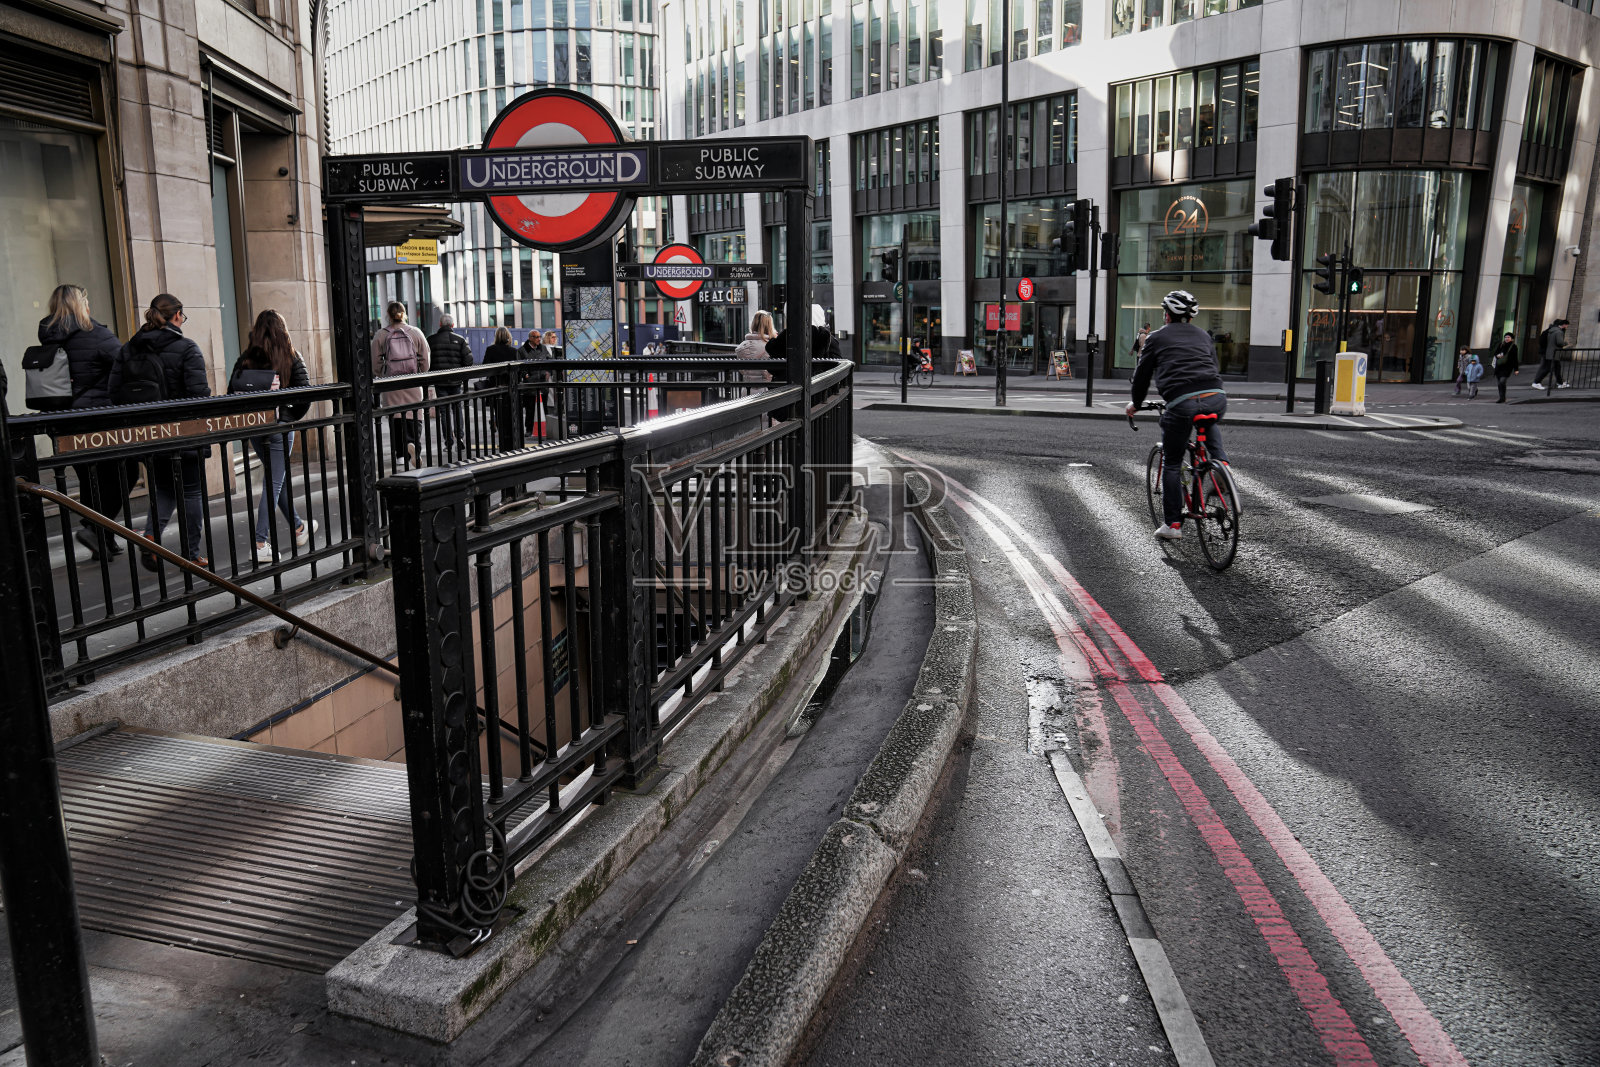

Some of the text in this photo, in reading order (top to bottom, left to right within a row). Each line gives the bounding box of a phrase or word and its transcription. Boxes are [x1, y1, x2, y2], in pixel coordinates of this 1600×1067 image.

[700, 147, 759, 162] PUBLIC
[363, 161, 414, 177] PUBLIC
[466, 152, 641, 188] UNDERGROUND
[695, 164, 765, 180] SUBWAY
[359, 177, 419, 193] SUBWAY
[1173, 208, 1201, 234] 24
[646, 265, 712, 278] UNDERGROUND
[699, 291, 709, 303] BE
[712, 290, 724, 302] AT
[73, 411, 267, 450] MONUMENT STATION
